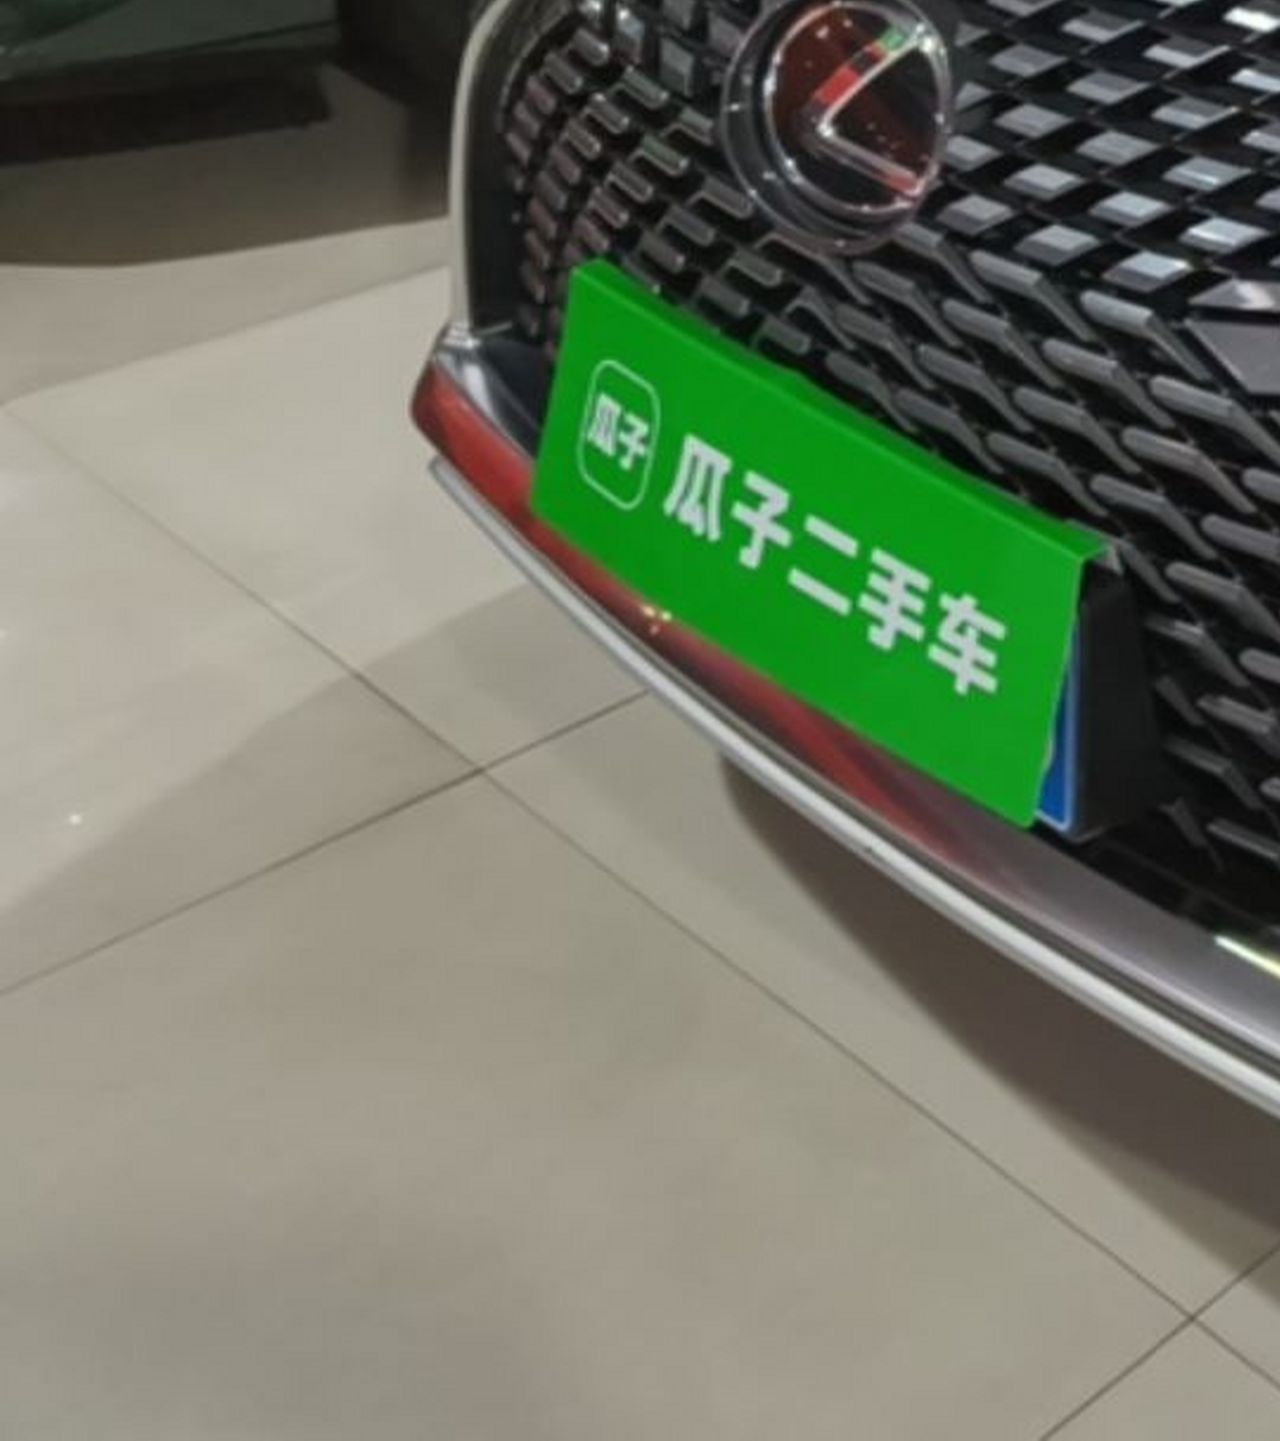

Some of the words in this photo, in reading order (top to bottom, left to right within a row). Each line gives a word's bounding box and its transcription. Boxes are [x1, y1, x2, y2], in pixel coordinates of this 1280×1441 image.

[587, 392, 649, 470] 瓜子
[663, 433, 1006, 695] 瓜子二手车
